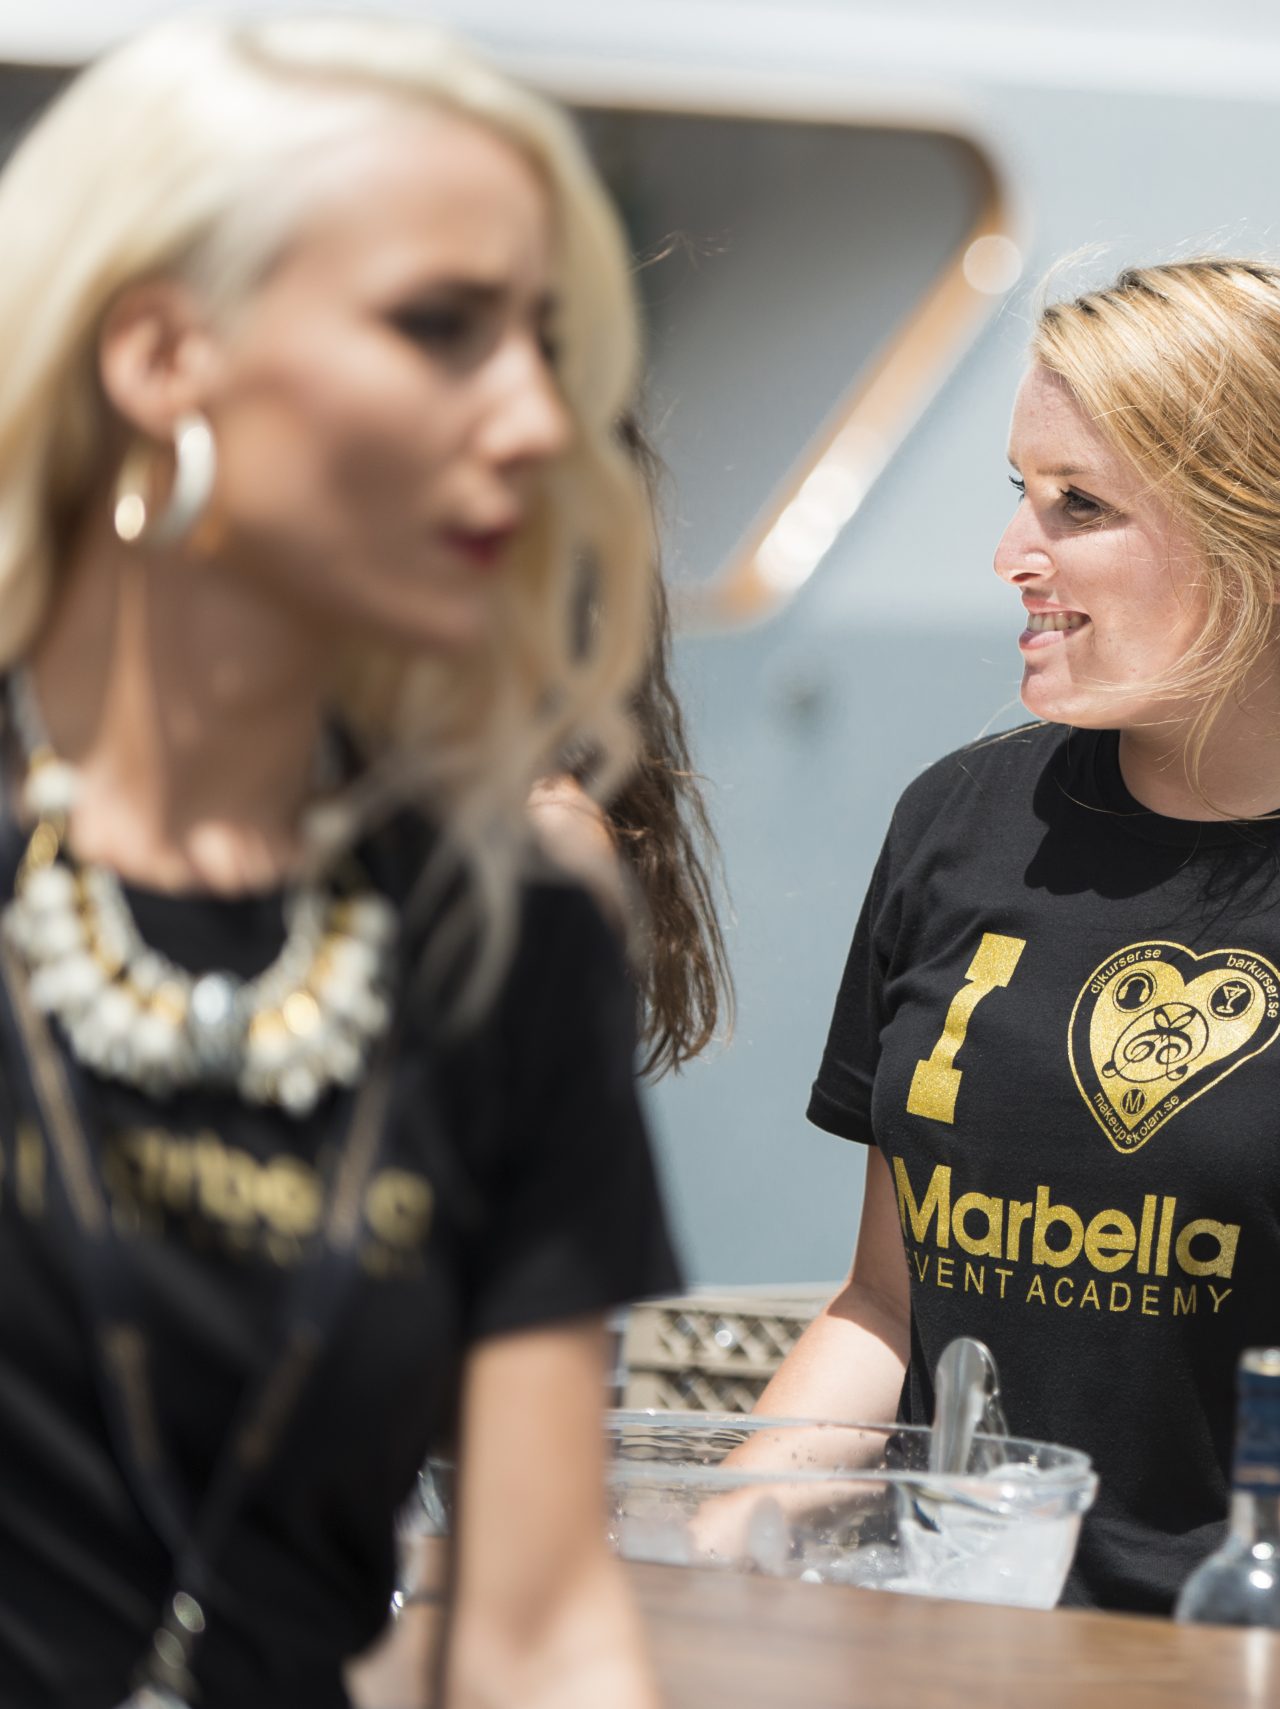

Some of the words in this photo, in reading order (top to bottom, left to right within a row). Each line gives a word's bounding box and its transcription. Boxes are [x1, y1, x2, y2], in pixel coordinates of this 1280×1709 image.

[1090, 949, 1162, 995] djkurser.se
[1226, 954, 1278, 1018] barkurser.se
[906, 932, 1027, 1125] I
[1093, 1092, 1180, 1146] makeupskolan.se
[892, 1156, 1241, 1280] Marbella
[907, 1248, 1014, 1300] VENT
[1025, 1273, 1233, 1316] ACADEMY
